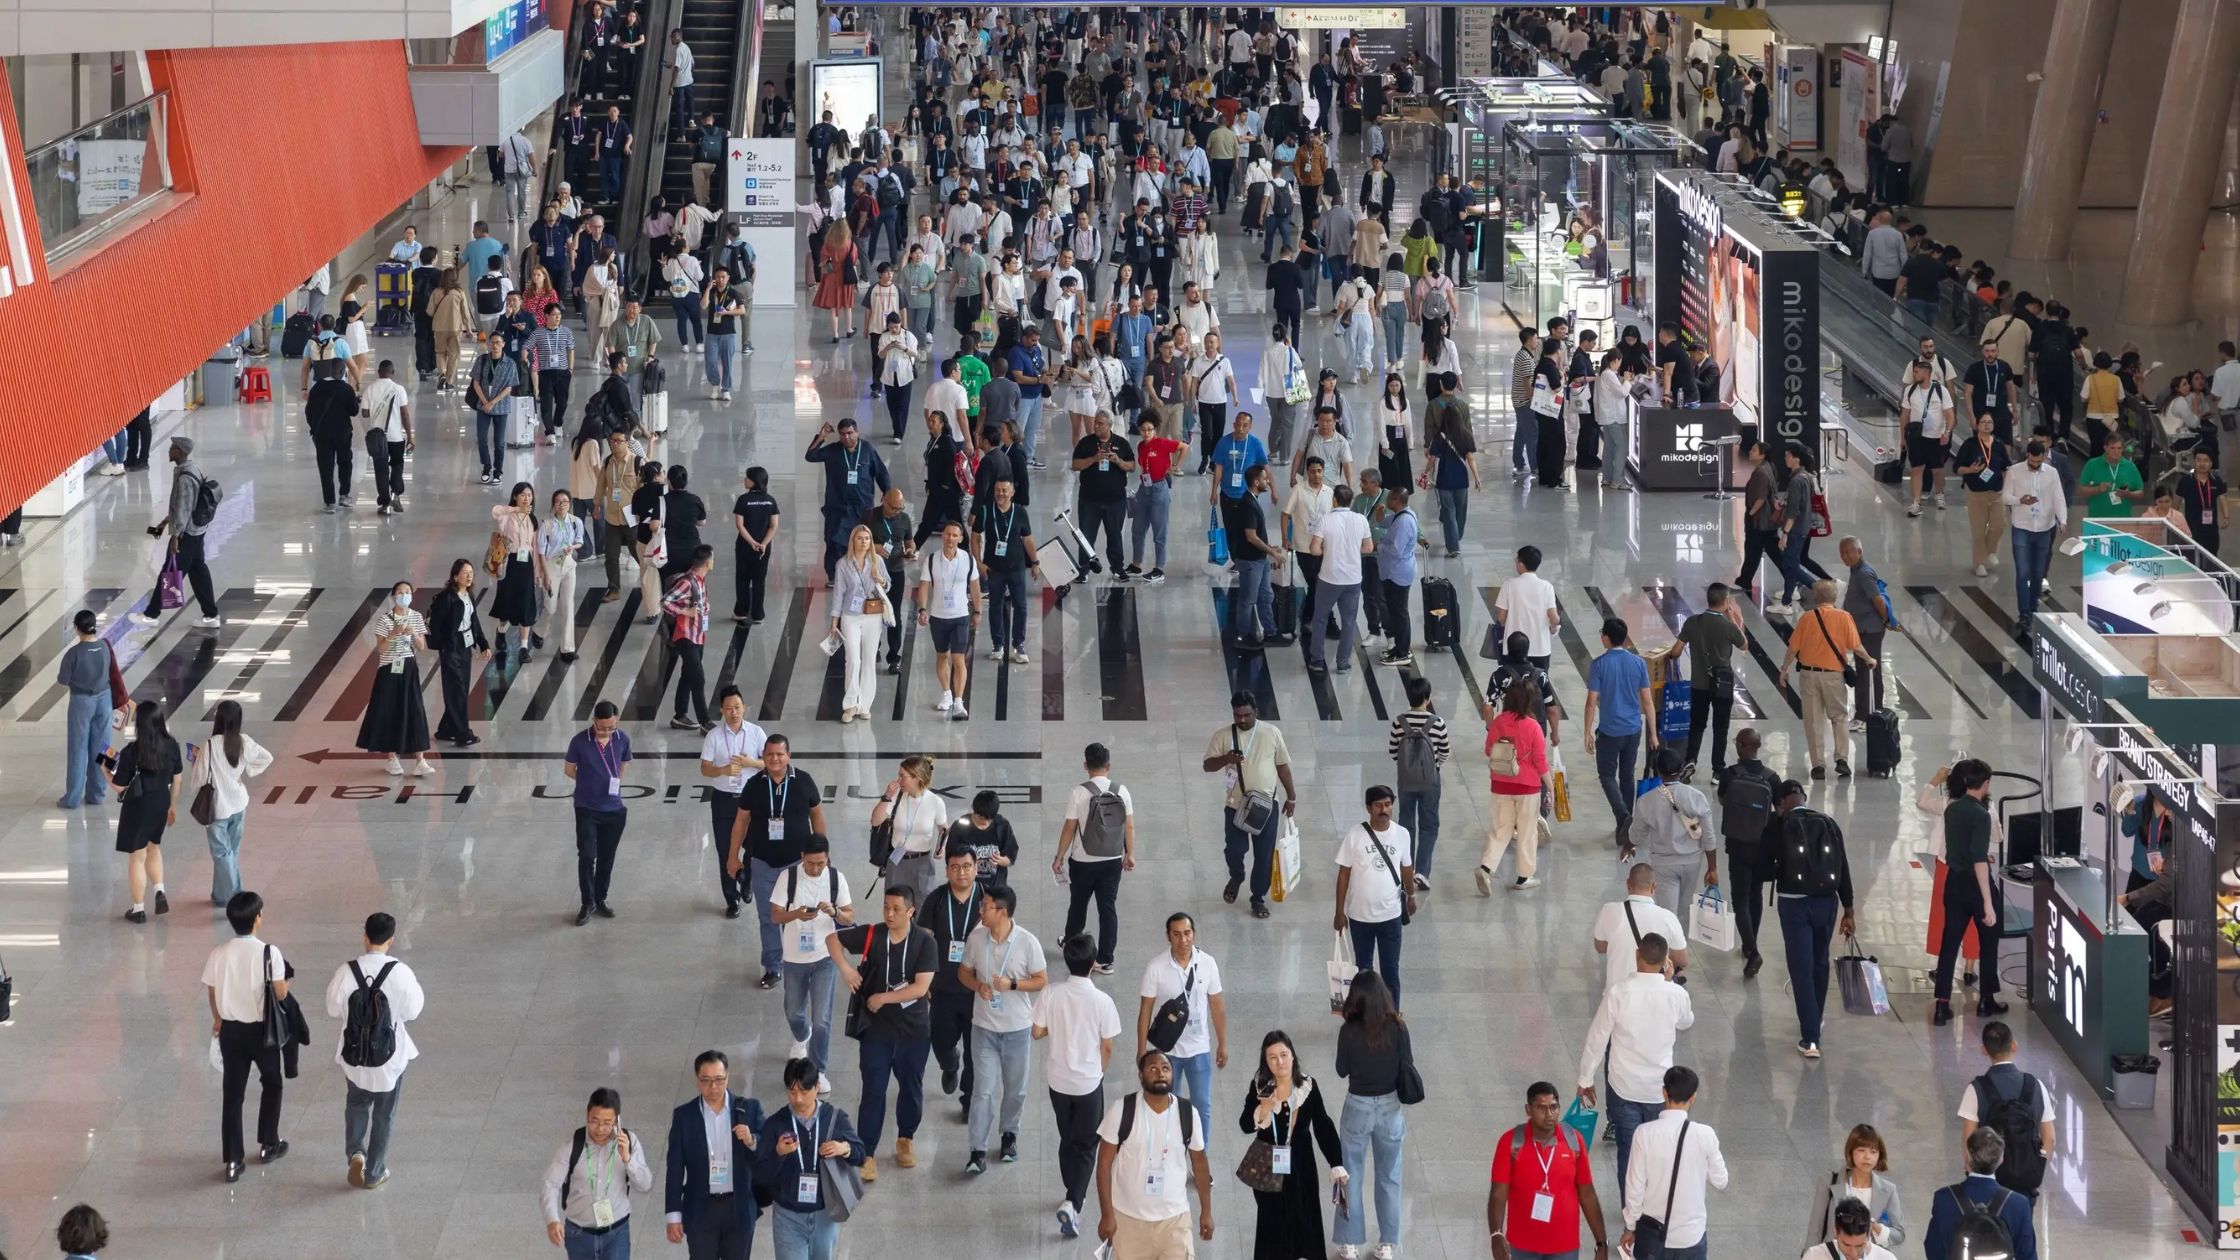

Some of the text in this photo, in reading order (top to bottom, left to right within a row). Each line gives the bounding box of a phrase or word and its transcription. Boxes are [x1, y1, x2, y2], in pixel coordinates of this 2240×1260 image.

[758, 163, 782, 172] 1.2-5.2
[1679, 178, 1721, 247] mikodesign
[1776, 281, 1807, 444] mikodesig
[1661, 453, 1719, 464] mikodesign
[263, 785, 1043, 804] Exition Hall
[2119, 727, 2190, 812] BRAND STRATEGY
[2047, 899, 2058, 1002] paris
